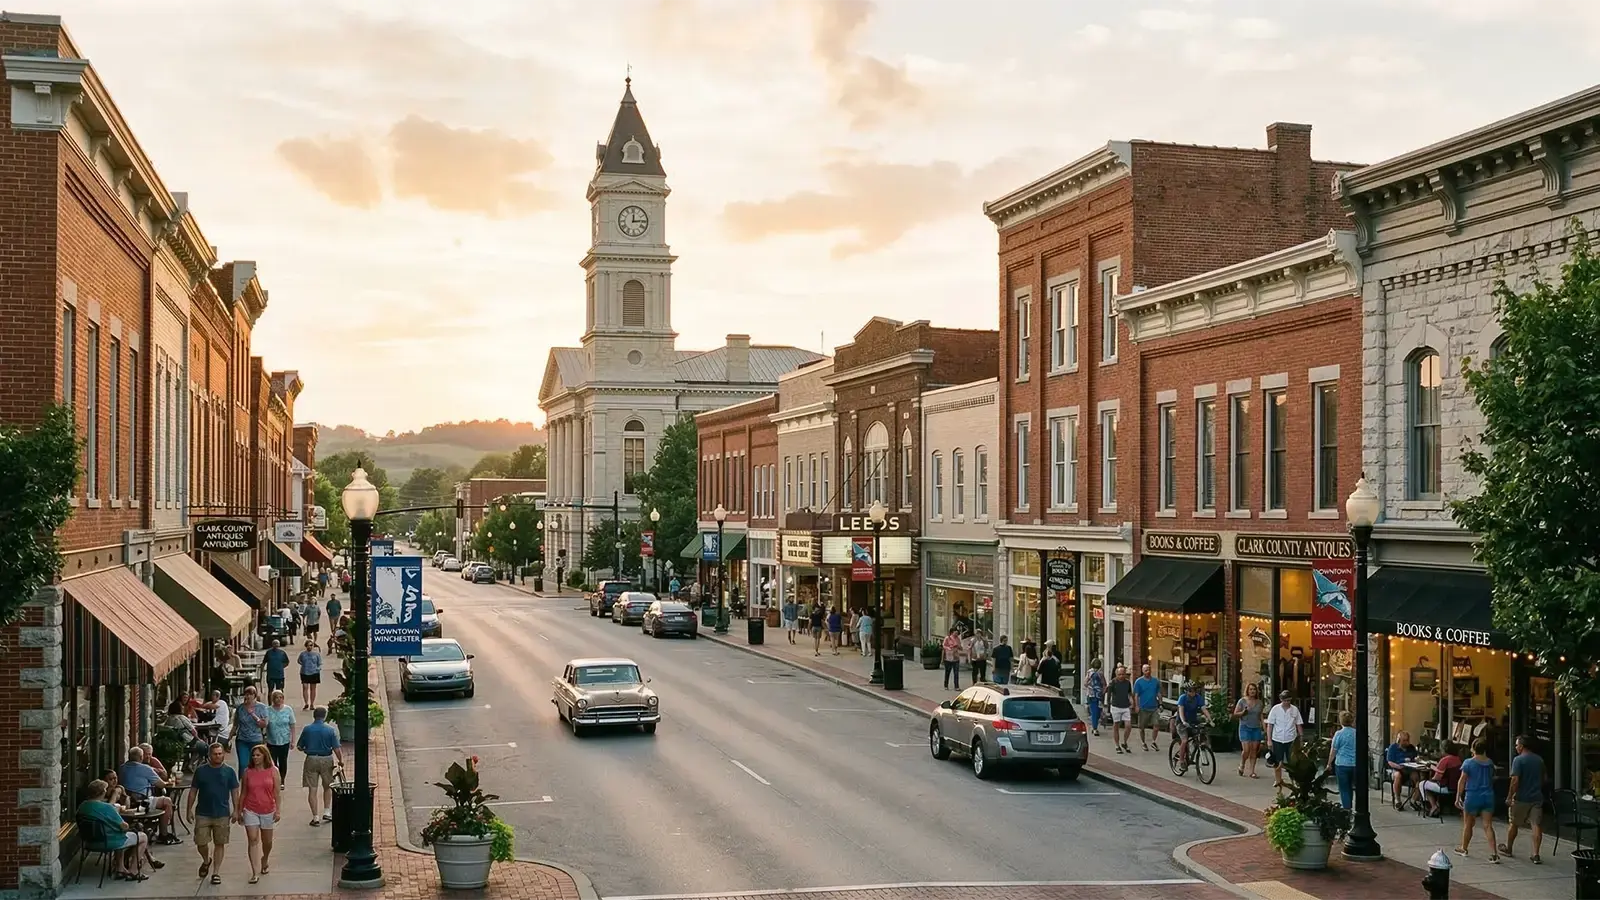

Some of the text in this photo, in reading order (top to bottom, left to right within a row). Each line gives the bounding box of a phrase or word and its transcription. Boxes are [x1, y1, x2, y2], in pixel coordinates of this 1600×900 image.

[1150, 536, 1214, 550] BOOKS & COFFEE
[1238, 538, 1350, 560] CLARK COUNTY ANTIQUES
[1396, 622, 1490, 646] BOOKS & COFFEE
